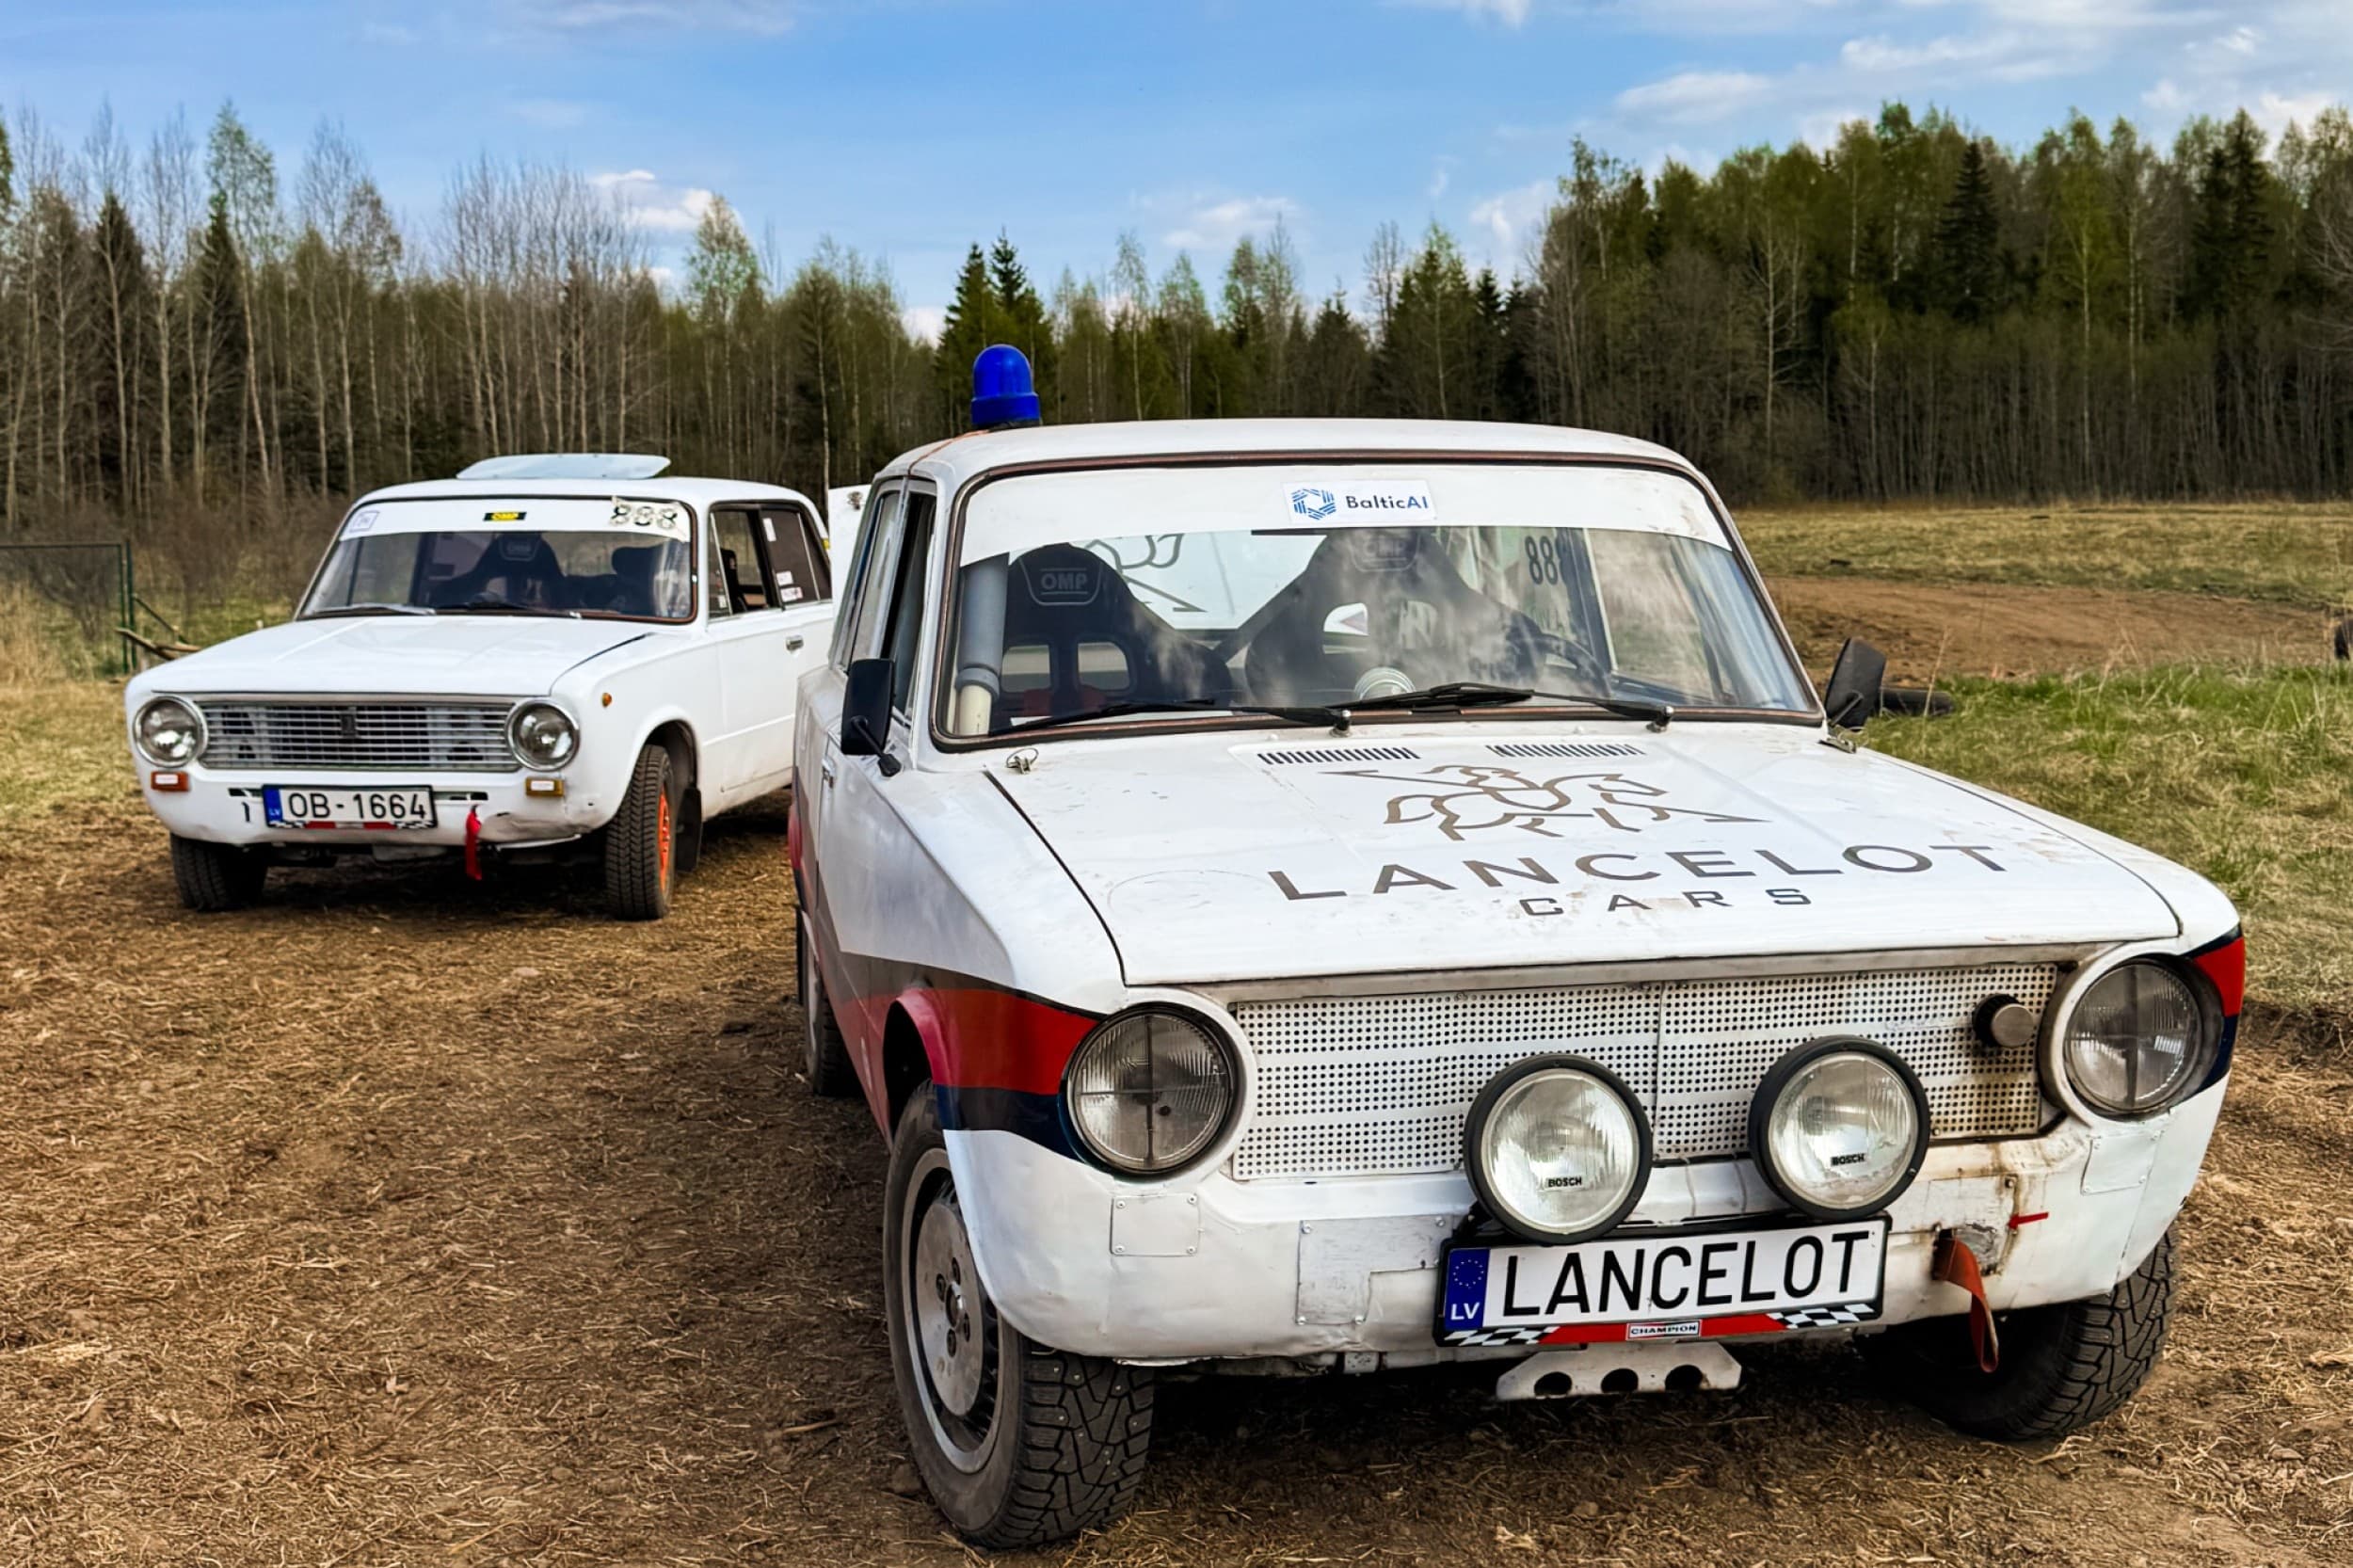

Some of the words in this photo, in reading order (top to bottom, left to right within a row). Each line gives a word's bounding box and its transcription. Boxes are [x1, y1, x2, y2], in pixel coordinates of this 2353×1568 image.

[1345, 495, 1429, 509] BalticAI
[1041, 572, 1088, 590] OMP
[1268, 845, 2008, 901] LANCELOT
[1519, 888, 1812, 916] CARS
[1831, 1154, 1865, 1167] BOSCH
[1547, 1176, 1583, 1188] BOSCH
[1450, 1302, 1481, 1321] LV
[1502, 1230, 1870, 1318] LANCELOT
[1630, 1324, 1697, 1335] CHAMPION
